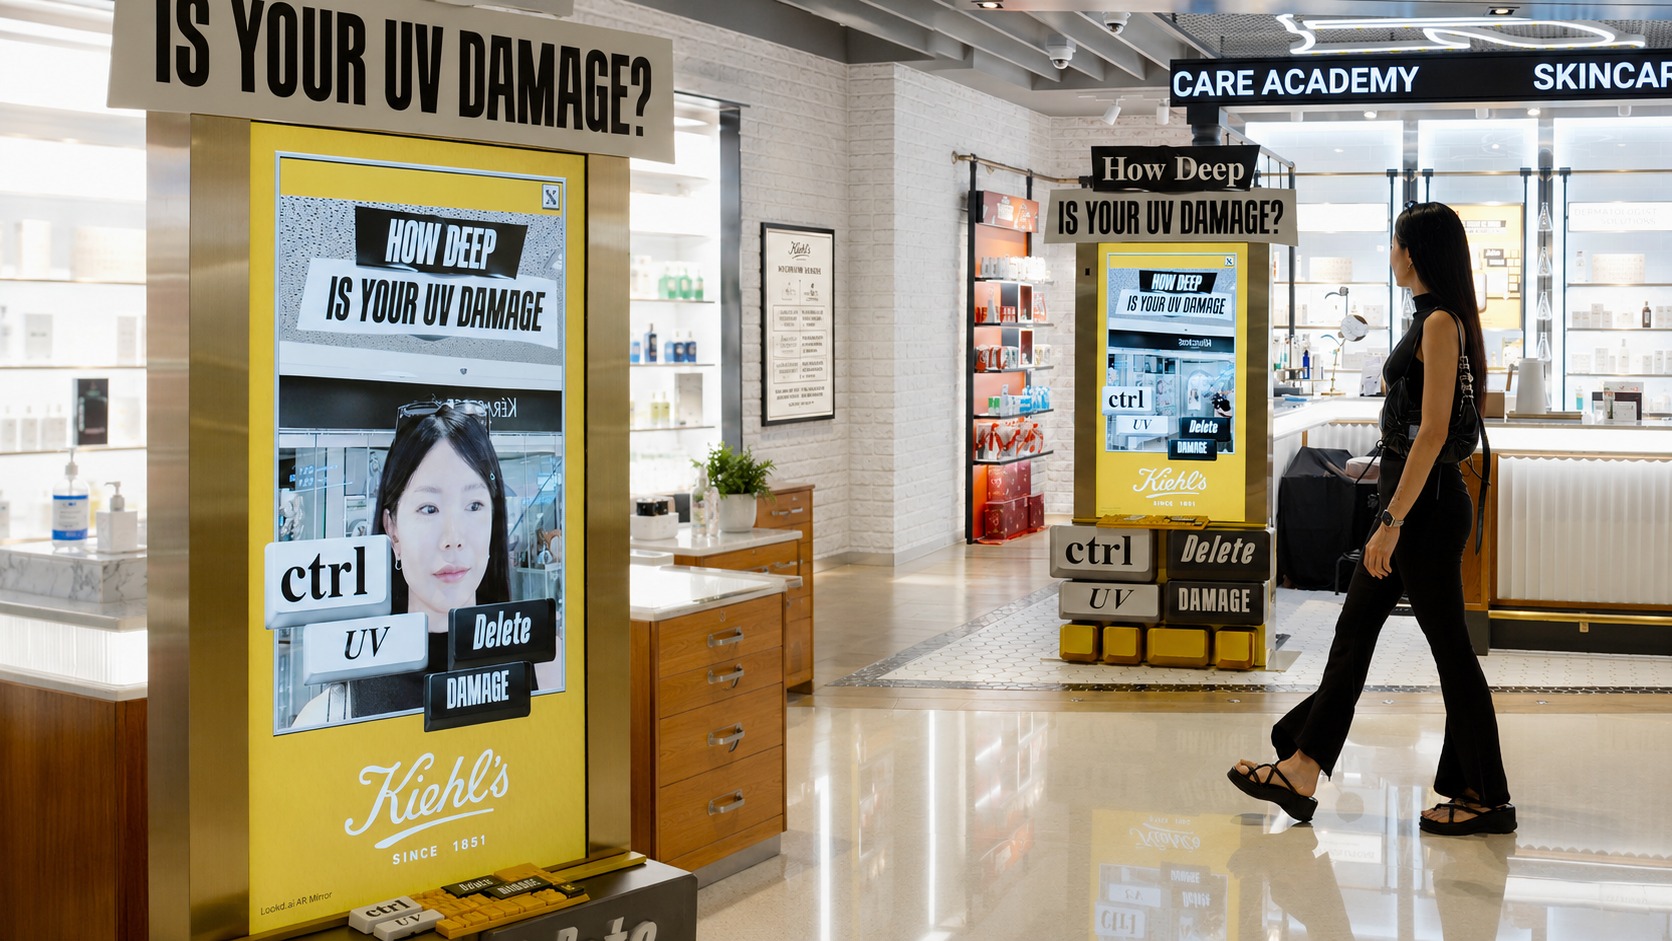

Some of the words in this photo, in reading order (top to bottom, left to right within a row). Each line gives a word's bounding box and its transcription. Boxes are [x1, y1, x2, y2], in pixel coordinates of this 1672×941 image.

[156, 0, 210, 87] IS
[231, 0, 367, 106] YOUR
[384, 19, 444, 114] UV
[458, 29, 652, 137] DAMAGE?
[1173, 68, 1255, 98] CARE
[1261, 65, 1420, 96] ACADEMY
[1101, 156, 1167, 181] How
[1174, 156, 1245, 187] Deep
[1058, 200, 1078, 235] IS
[1085, 200, 1140, 235] YOUR
[1147, 200, 1174, 235] UV
[1180, 199, 1284, 235] DAMAGE?
[385, 218, 442, 266] HOW
[443, 224, 497, 270] DEEP
[1151, 273, 1177, 291] HOW
[1176, 274, 1203, 292] DEEP
[325, 276, 353, 321] IS
[360, 278, 420, 325] YOUR
[423, 283, 455, 327] UV
[457, 285, 546, 332] DAMAGE
[1127, 295, 1138, 311] IS
[1140, 295, 1166, 312] YOUR
[1167, 296, 1182, 313] UV
[1182, 297, 1226, 315] DAMAGE
[1108, 390, 1144, 408] ctrl
[1132, 419, 1152, 431] UV
[1189, 420, 1219, 434] Delete
[1177, 441, 1208, 454] DAMAGE
[1132, 467, 1207, 492] Kiehl's
[1065, 535, 1133, 566] ctrl
[1180, 534, 1256, 564] Delete
[280, 546, 368, 603] ctrl
[1089, 588, 1134, 610] UV
[1178, 587, 1250, 613] DAMAGE
[343, 626, 391, 661] UV
[472, 610, 532, 651] Delete
[446, 669, 510, 710] DAMAGE
[344, 748, 509, 837] Kiehl's
[392, 845, 438, 865] SINCE
[453, 834, 486, 852] 1851
[296, 896, 308, 907] AR
[309, 891, 333, 904] Mirror
[365, 899, 411, 918] ctrl
[395, 913, 422, 927] UV
